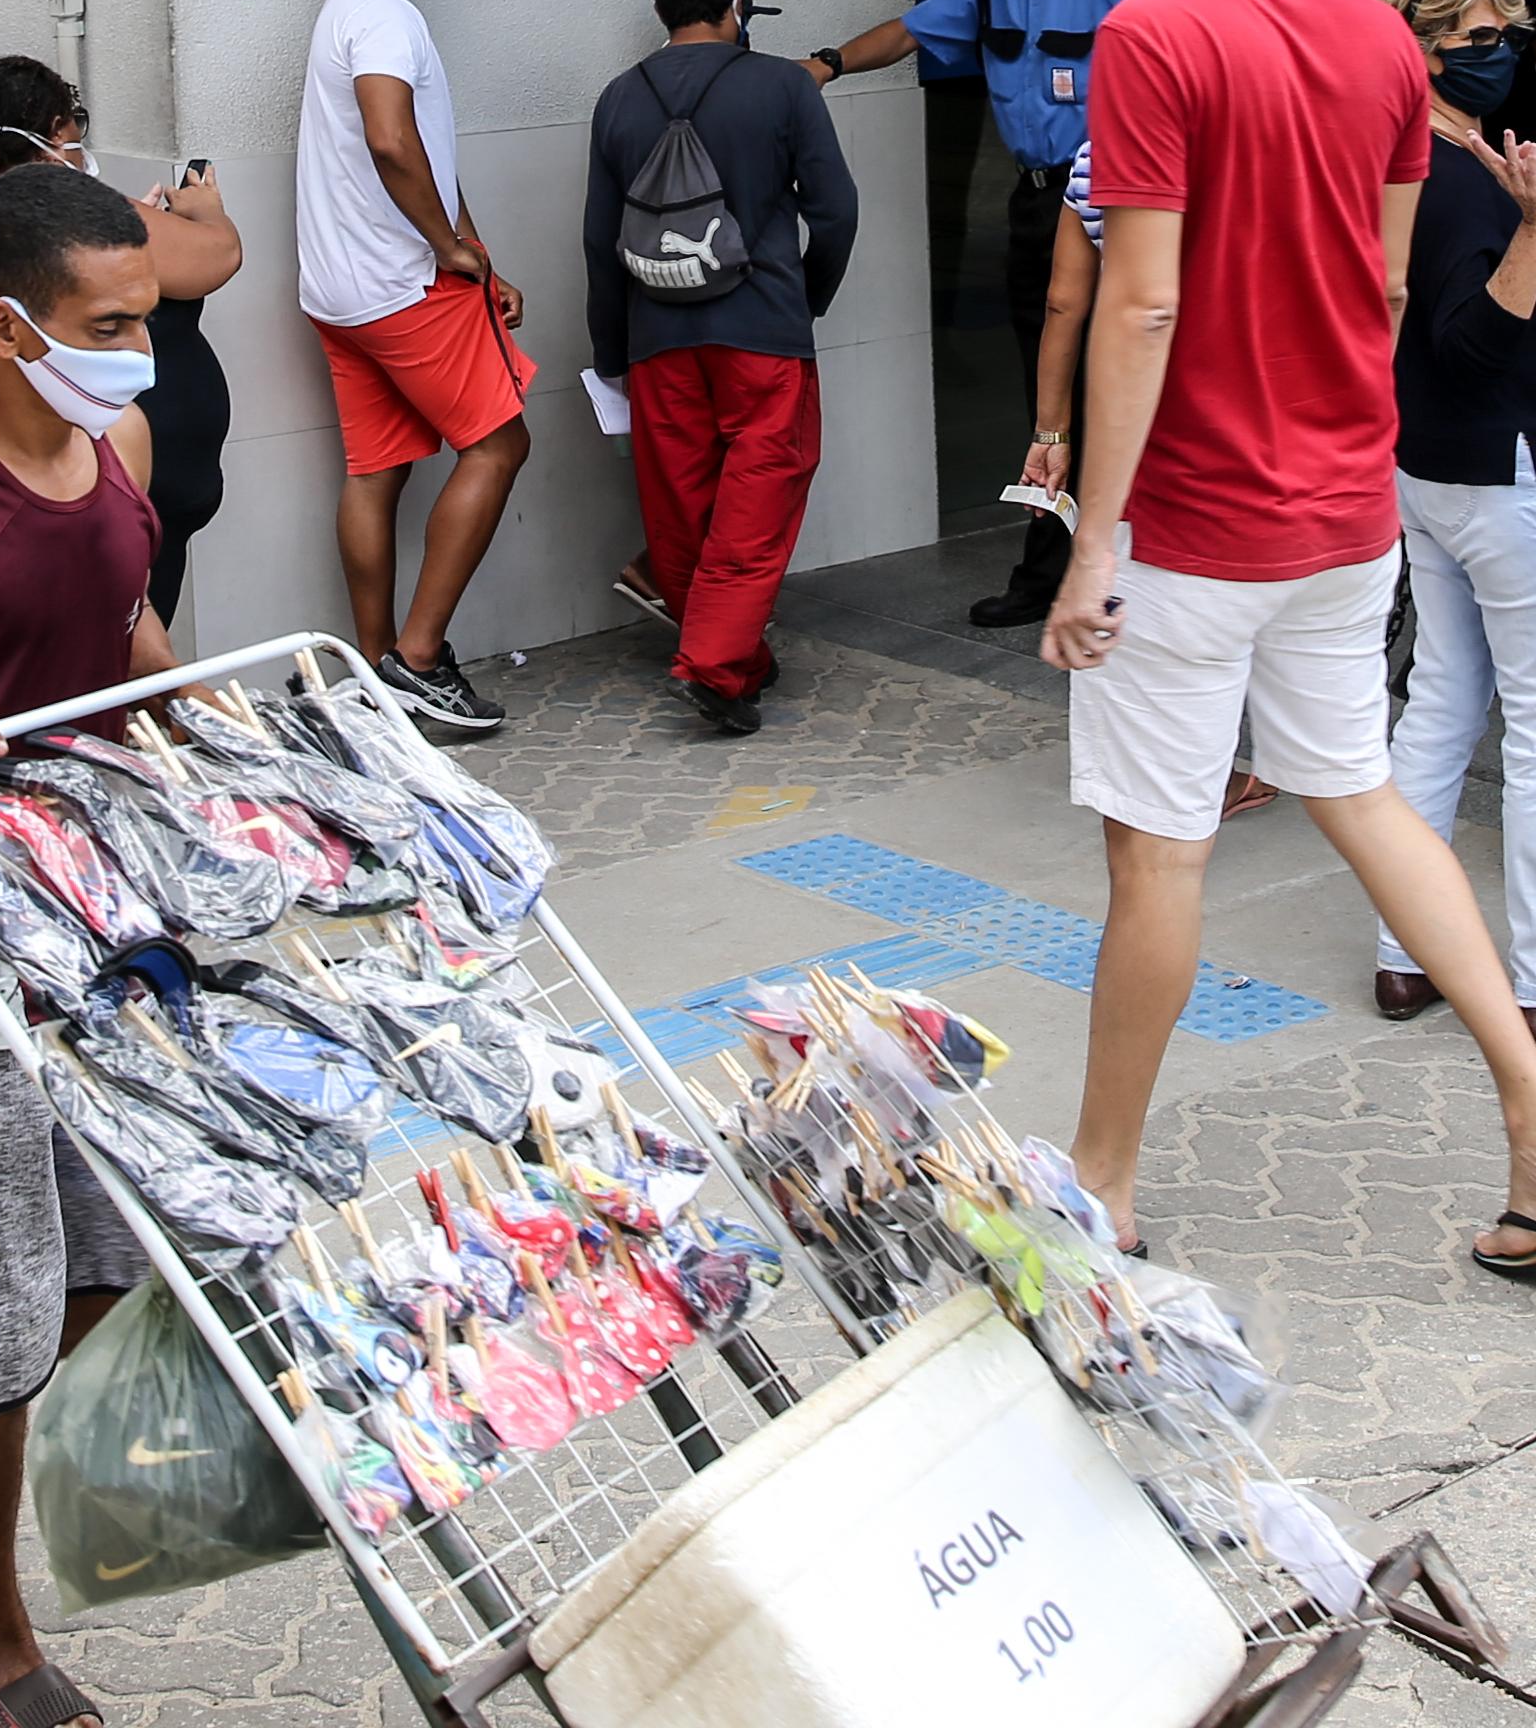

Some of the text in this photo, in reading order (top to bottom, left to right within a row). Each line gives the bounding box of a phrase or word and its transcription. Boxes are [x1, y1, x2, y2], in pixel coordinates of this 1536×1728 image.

[624, 248, 706, 288] PUMA
[914, 1509, 1026, 1610] ÁGUA
[997, 1599, 1074, 1683] 1,00
